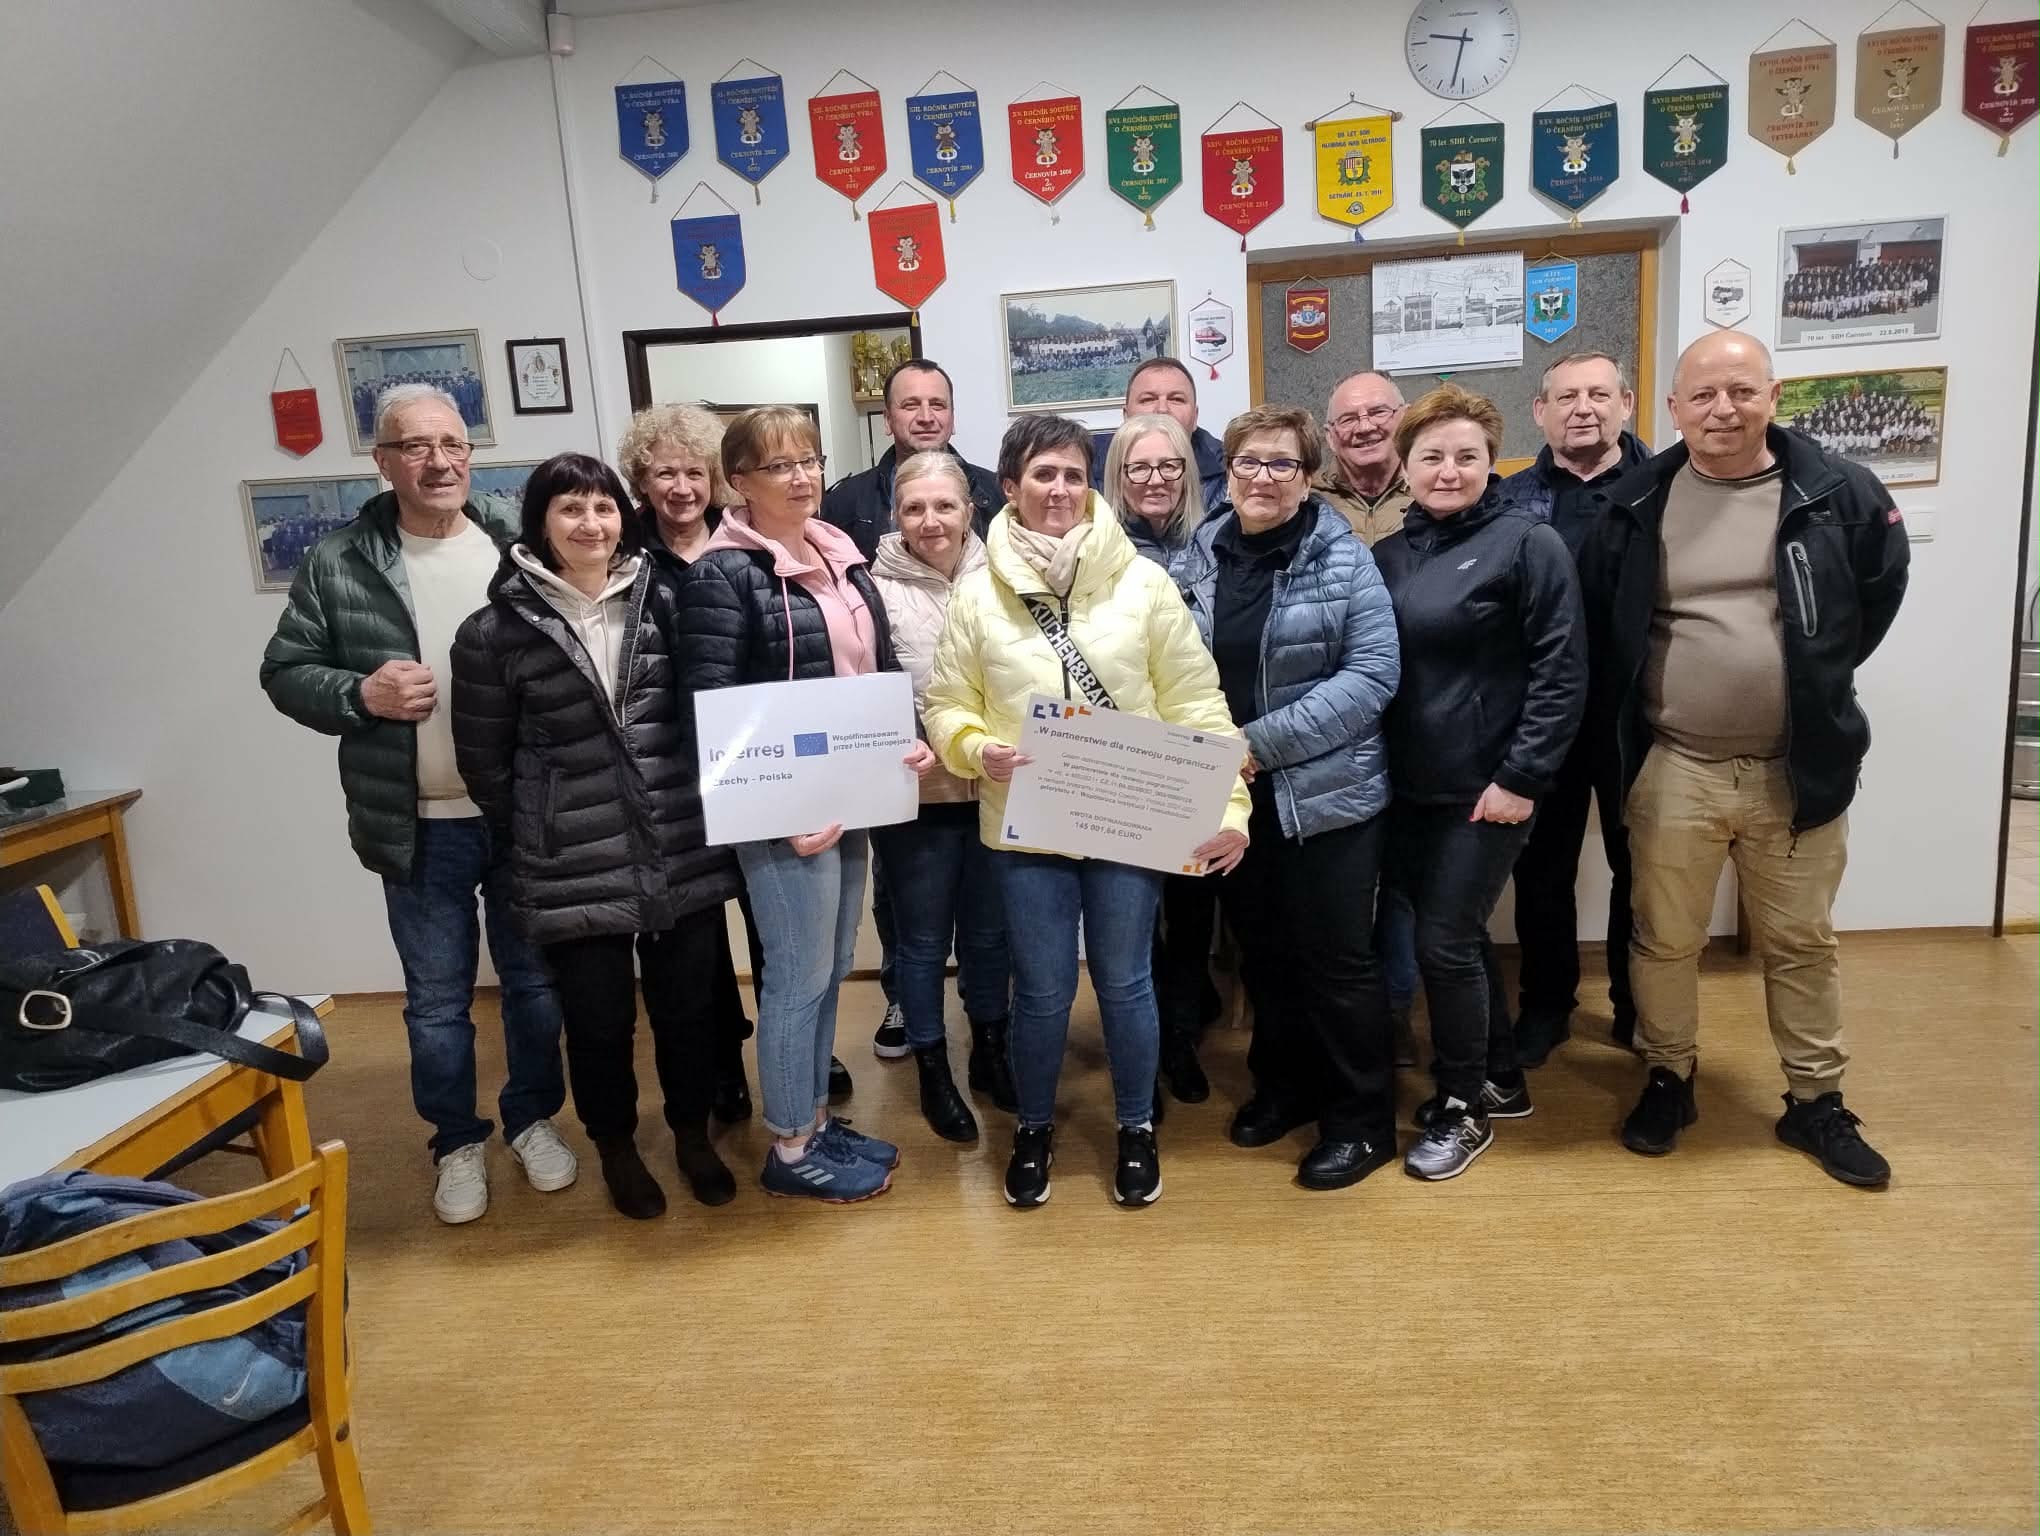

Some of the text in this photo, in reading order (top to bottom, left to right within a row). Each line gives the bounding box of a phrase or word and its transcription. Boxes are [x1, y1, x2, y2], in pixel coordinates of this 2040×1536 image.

[1456, 209, 1472, 217] 2015
[1050, 729, 1108, 747] partnerstwie
[1109, 740, 1124, 750] dla
[1126, 745, 1163, 760] rozwoju
[759, 772, 793, 783] Polska
[1118, 829, 1142, 841] EURO
